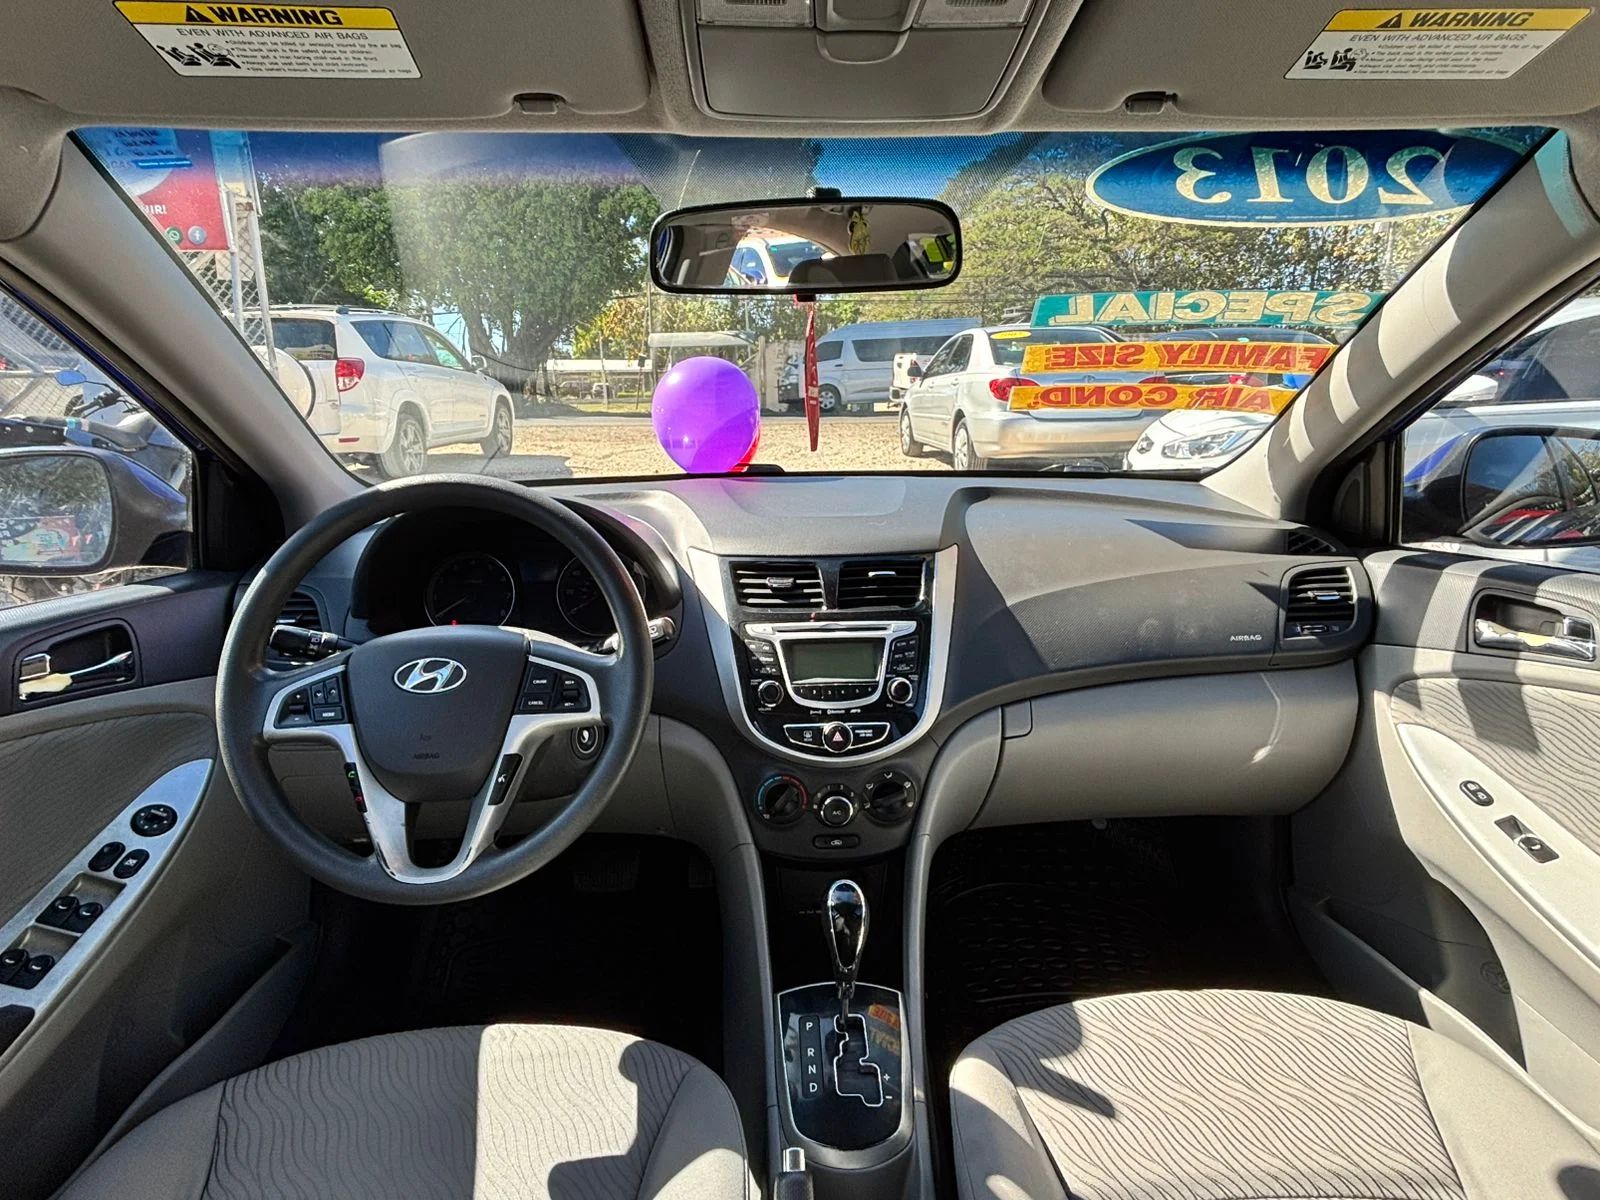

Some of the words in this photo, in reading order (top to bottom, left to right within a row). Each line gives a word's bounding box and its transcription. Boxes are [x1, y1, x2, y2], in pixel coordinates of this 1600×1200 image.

[207, 6, 343, 26] WARNING
[1408, 12, 1534, 27] WARNING
[176, 28, 211, 36] EVEN
[249, 30, 312, 38] ADVANCED
[806, 1022, 814, 1031] P
[807, 1048, 814, 1057] R
[808, 1064, 816, 1074] N
[810, 1082, 818, 1092] D
